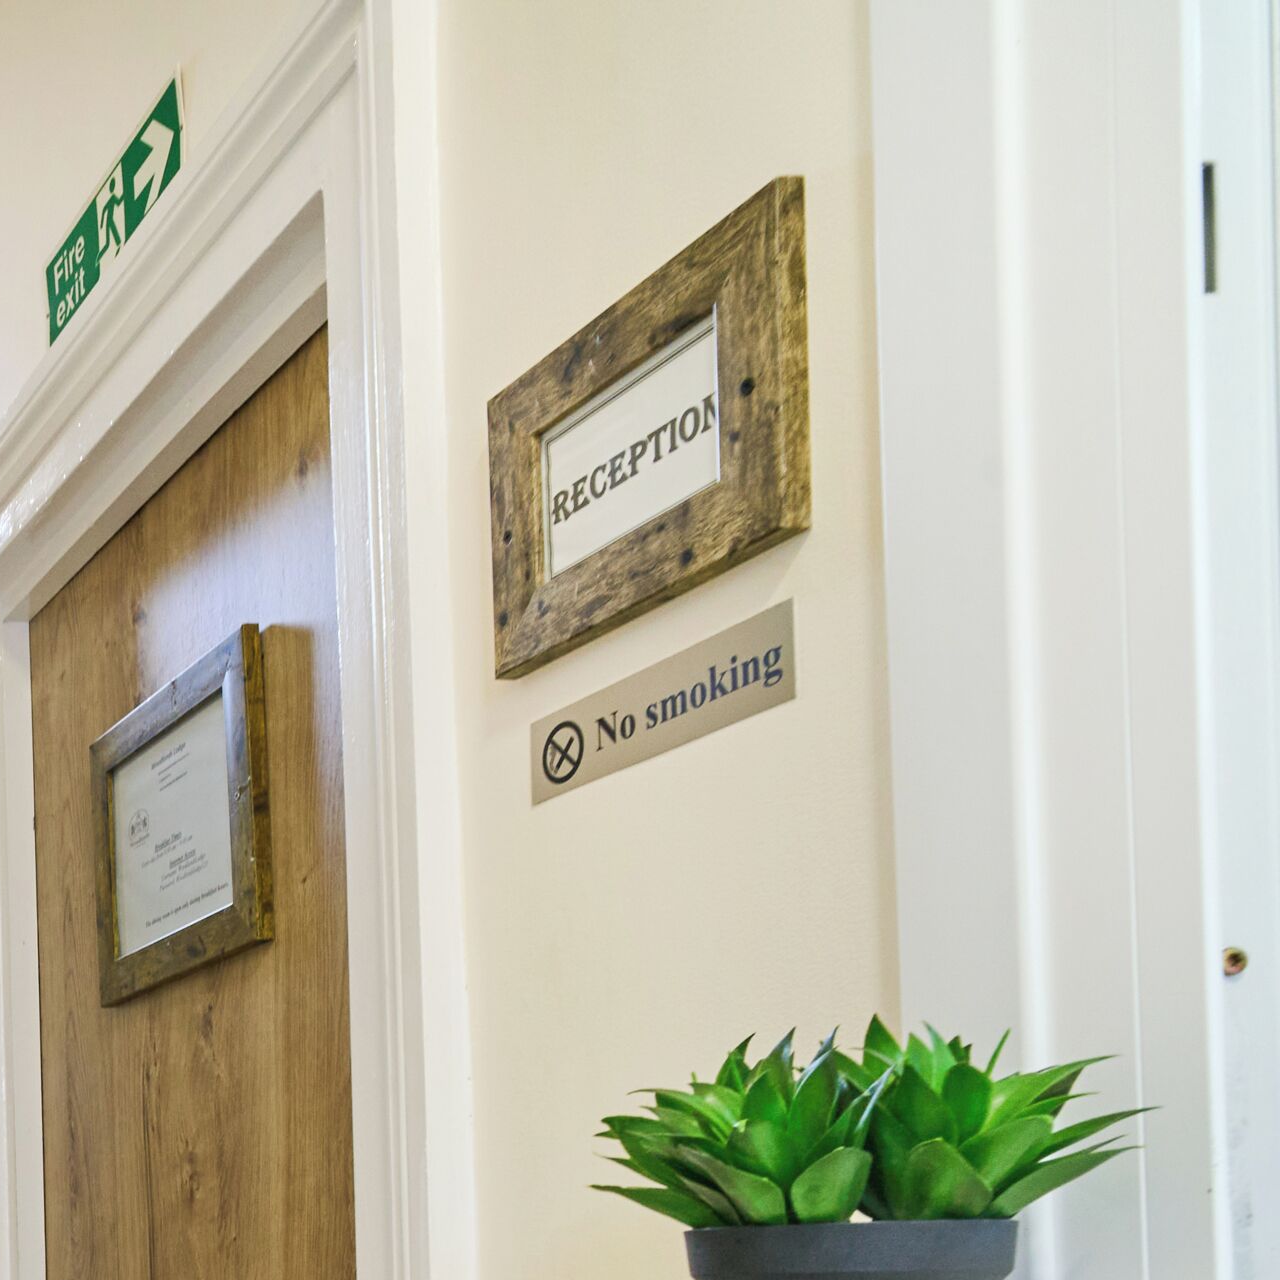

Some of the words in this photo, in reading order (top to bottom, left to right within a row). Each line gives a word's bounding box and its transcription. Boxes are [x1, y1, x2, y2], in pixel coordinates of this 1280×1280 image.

[53, 234, 85, 296] Fire
[56, 268, 86, 327] exit
[552, 391, 716, 525] RECEPTION
[596, 709, 636, 752] No
[645, 643, 784, 729] smoking
